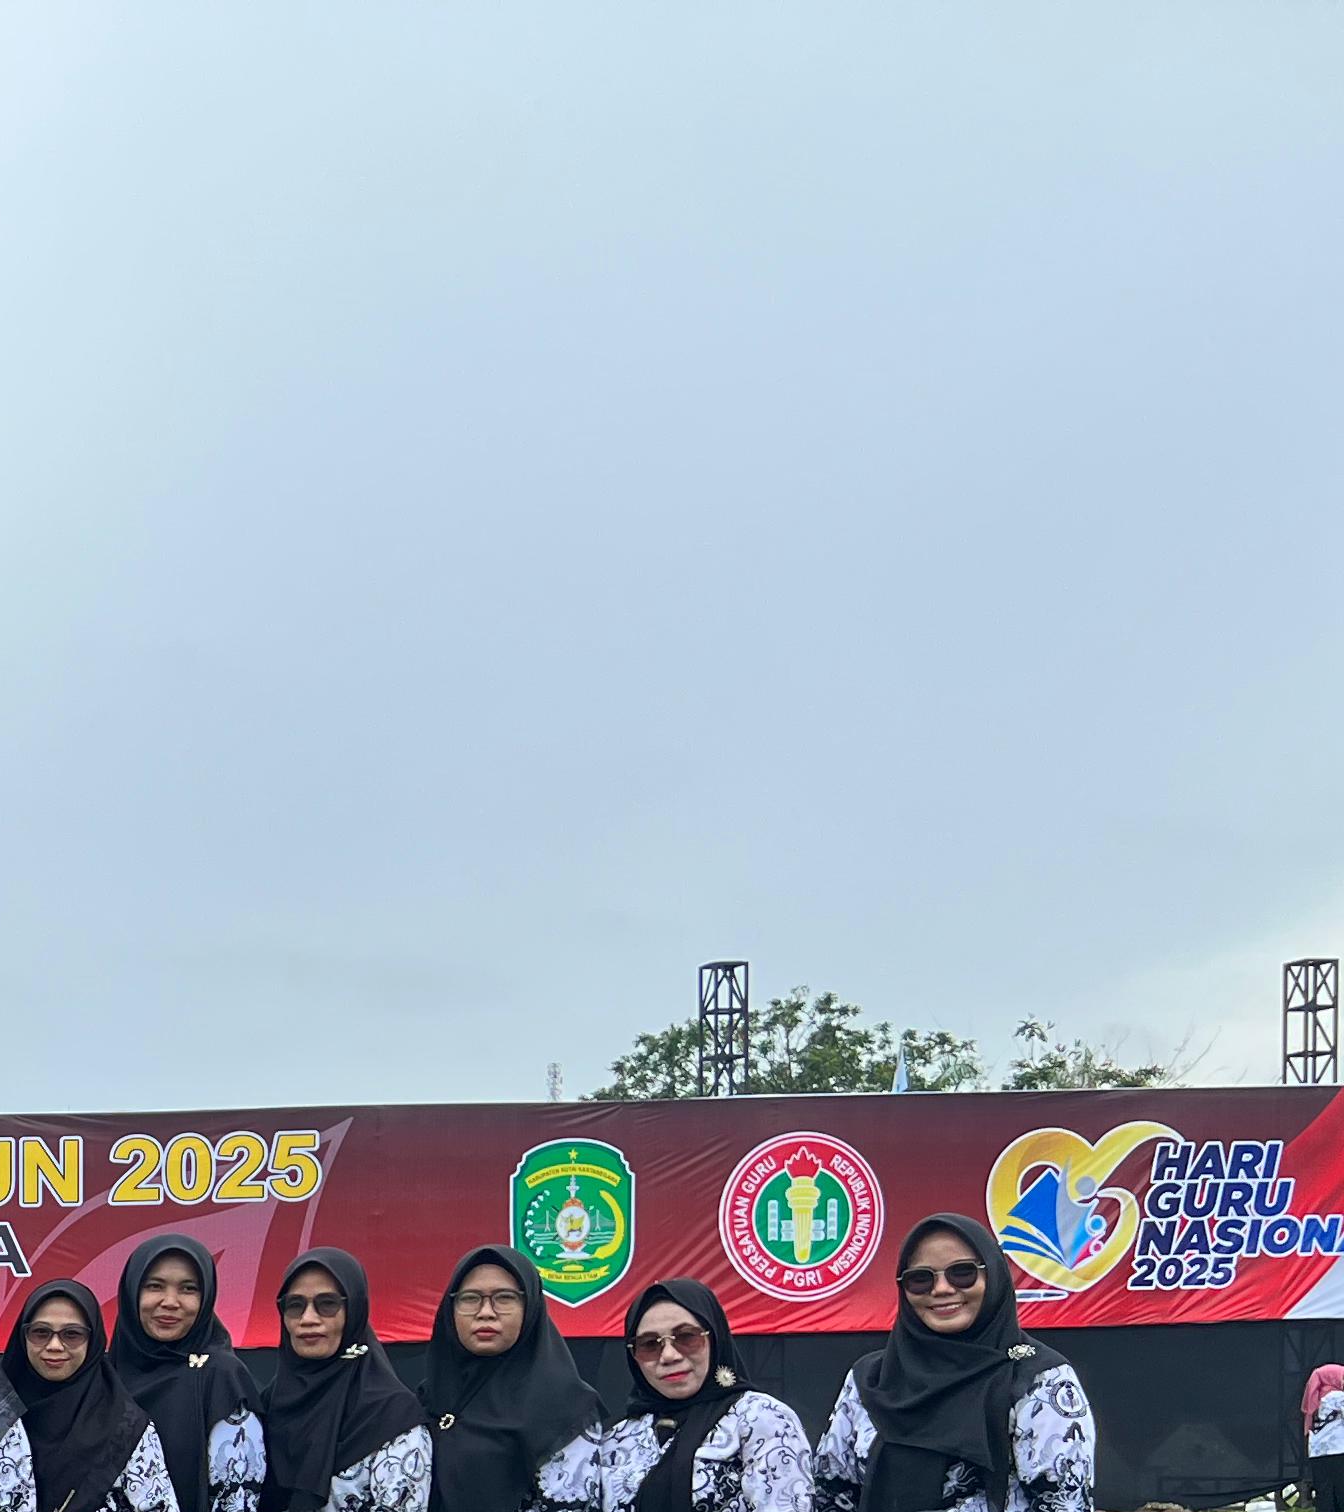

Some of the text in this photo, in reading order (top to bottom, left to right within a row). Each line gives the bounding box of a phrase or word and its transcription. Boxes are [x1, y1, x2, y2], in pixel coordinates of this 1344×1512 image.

[109, 1129, 322, 1206] 2025
[1152, 1141, 1283, 1182] HARI
[733, 1153, 871, 1279] PERSATUAN GURU REPUBLIK INDONESIA
[1146, 1179, 1294, 1219] GURU
[1137, 1216, 1344, 1257] NASION
[782, 1269, 823, 1287] PGRI
[1129, 1256, 1236, 1288] 2025
